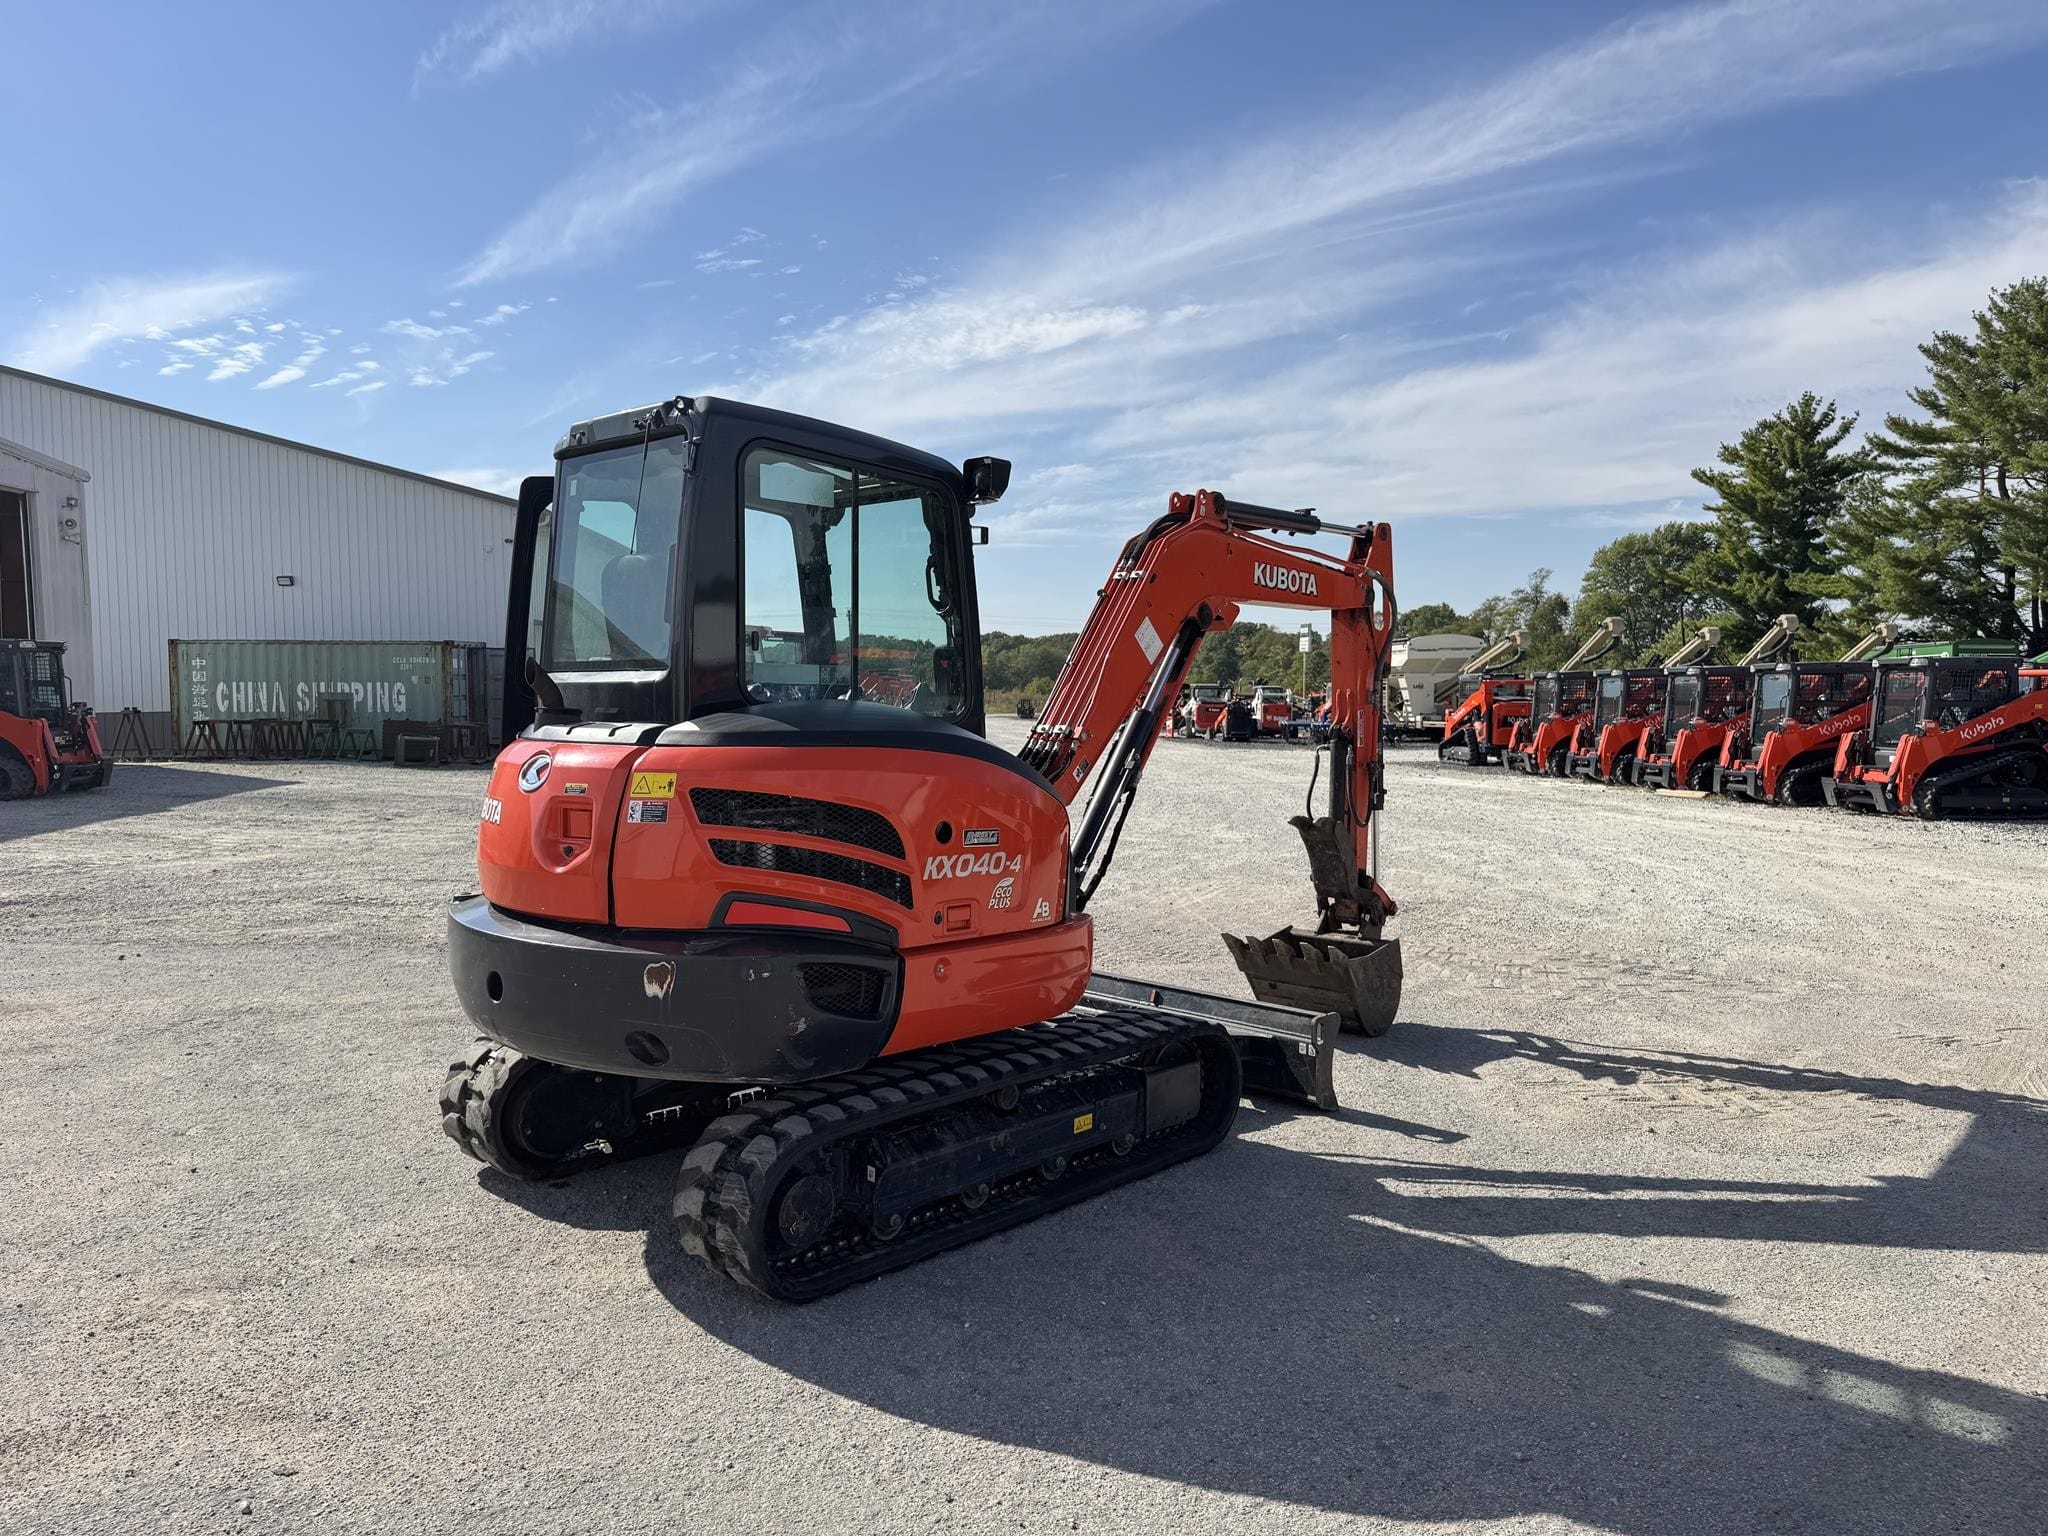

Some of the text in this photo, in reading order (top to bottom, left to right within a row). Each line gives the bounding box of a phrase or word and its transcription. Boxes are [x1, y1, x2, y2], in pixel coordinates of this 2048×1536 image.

[1253, 561, 1318, 596] KUBOTA
[215, 681, 286, 713] CHINA
[1819, 712, 1861, 735] Kubota
[1960, 715, 2005, 739] Kubota
[481, 798, 502, 824] BOTA
[923, 851, 1022, 881] KX040-4
[988, 899, 1011, 910] PLUS
[995, 886, 1012, 898] eco
